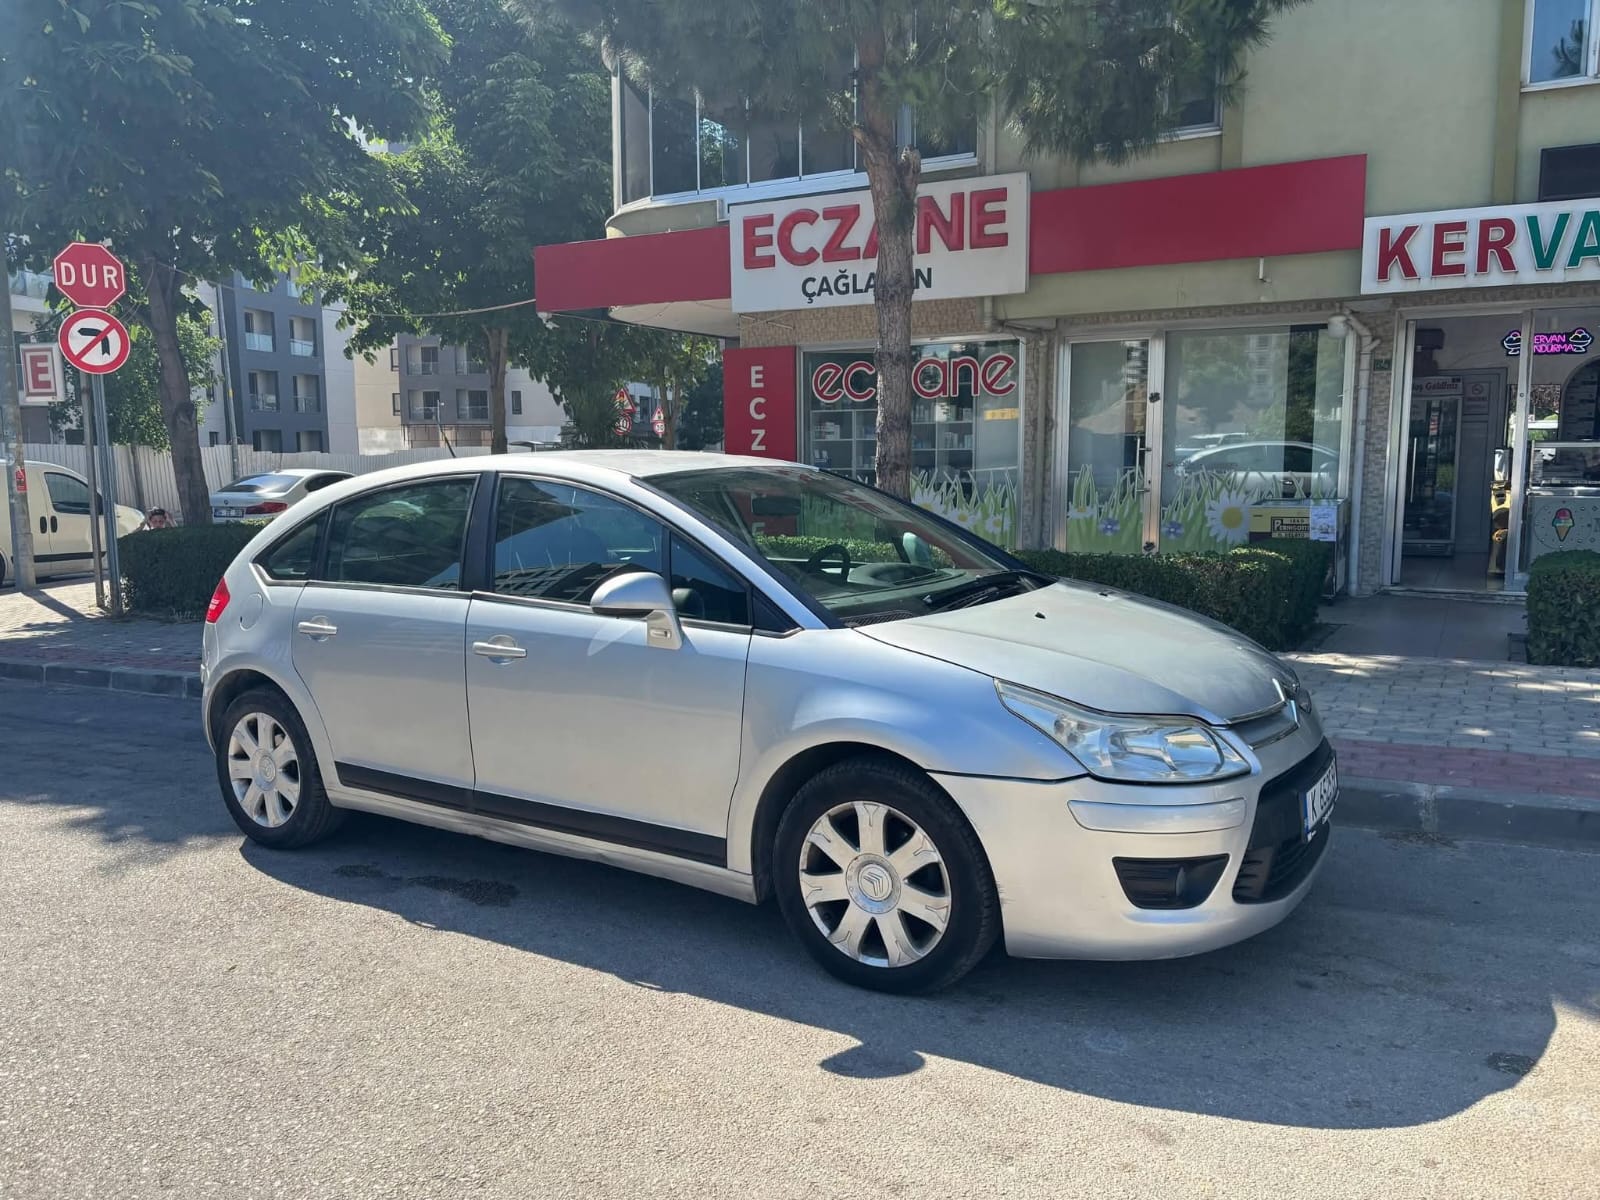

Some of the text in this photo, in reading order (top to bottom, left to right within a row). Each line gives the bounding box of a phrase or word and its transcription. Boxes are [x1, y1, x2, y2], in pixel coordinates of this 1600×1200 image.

[742, 187, 1009, 270] ECZNE
[60, 261, 118, 289] DUR
[801, 267, 932, 303] ÇAĞLAN
[1534, 334, 1566, 344] ERVAN
[30, 354, 52, 390] E
[811, 353, 1017, 403] ecane
